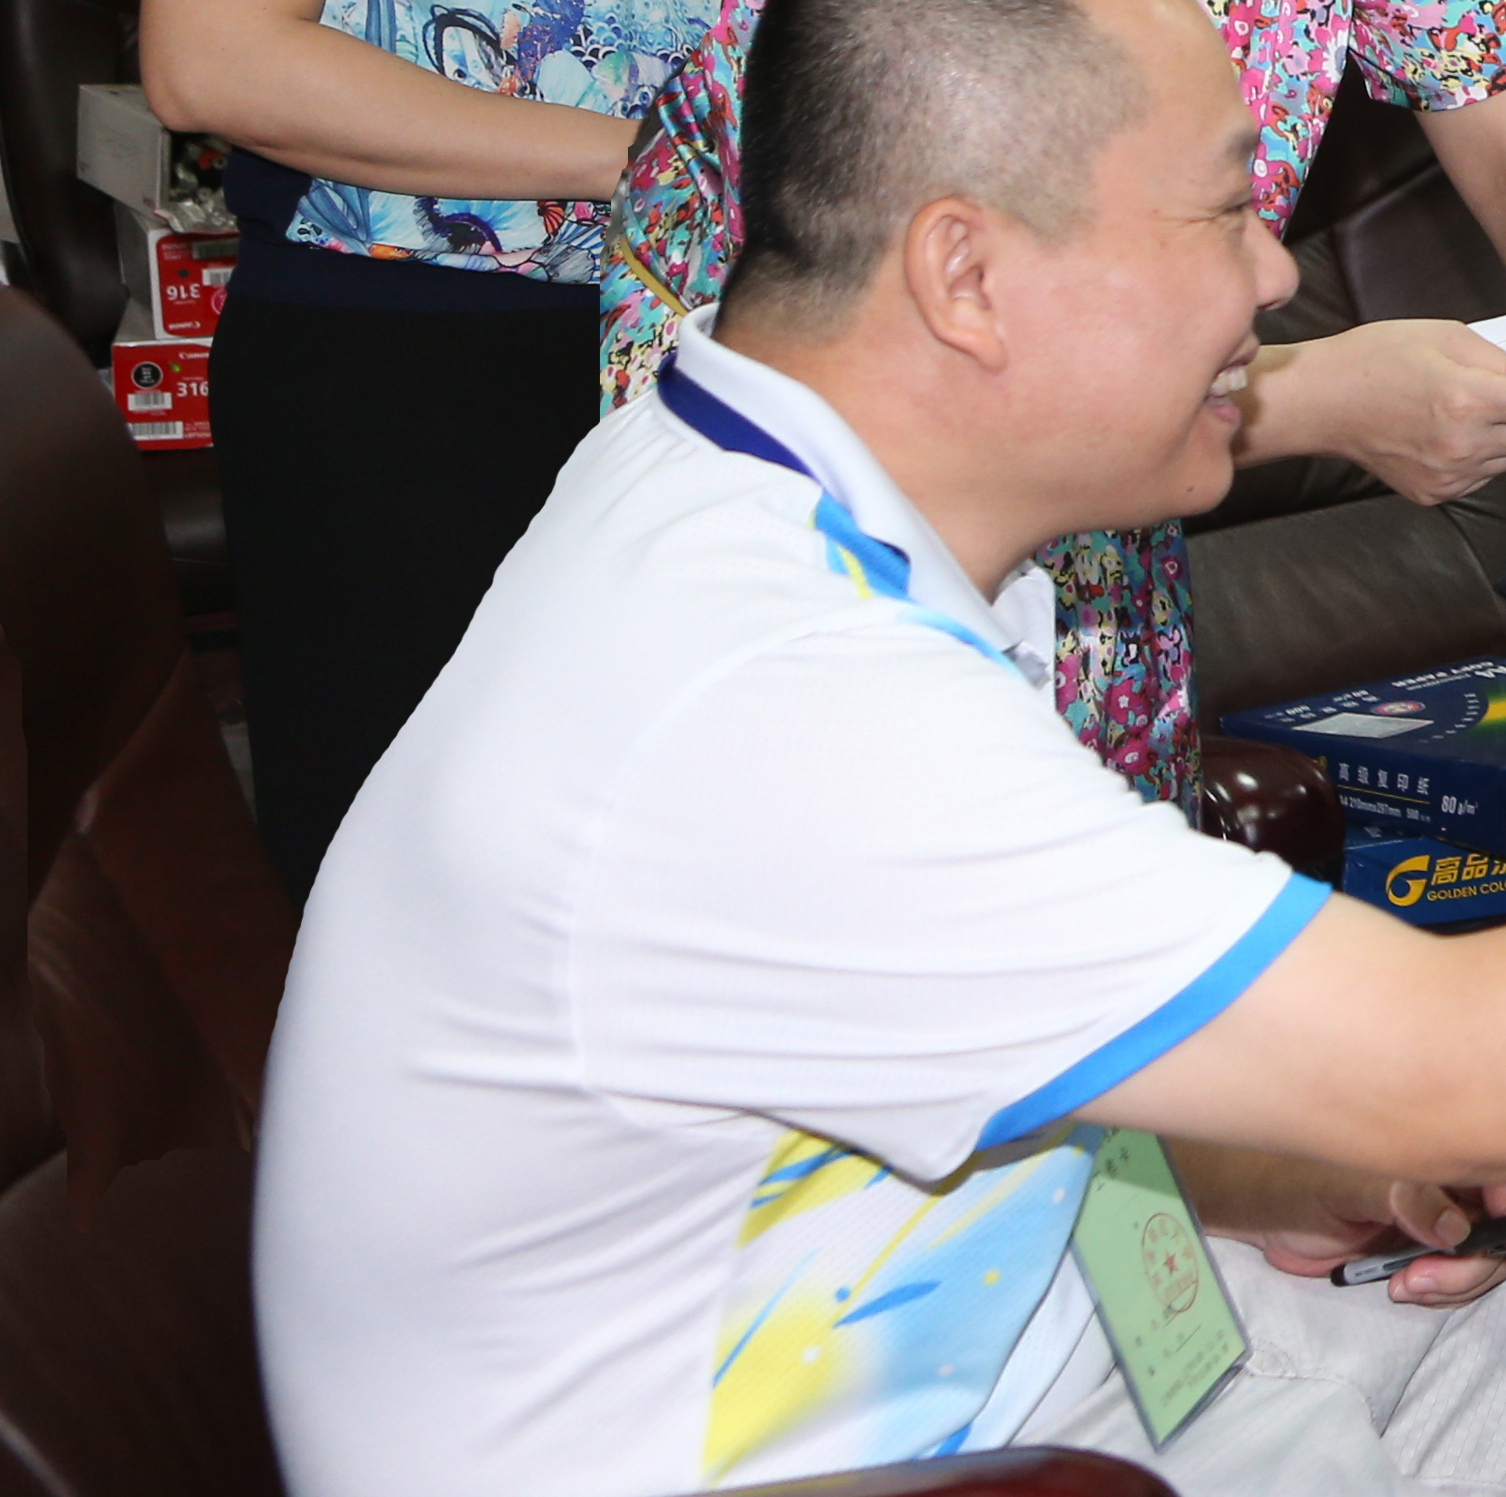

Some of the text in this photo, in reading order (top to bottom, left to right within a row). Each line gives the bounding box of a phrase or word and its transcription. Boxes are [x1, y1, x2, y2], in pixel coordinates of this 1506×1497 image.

[166, 283, 201, 301] 316
[177, 381, 209, 397] 316
[1338, 762, 1431, 796] 高级复印纸
[1427, 884, 1477, 902] GOLDEN
